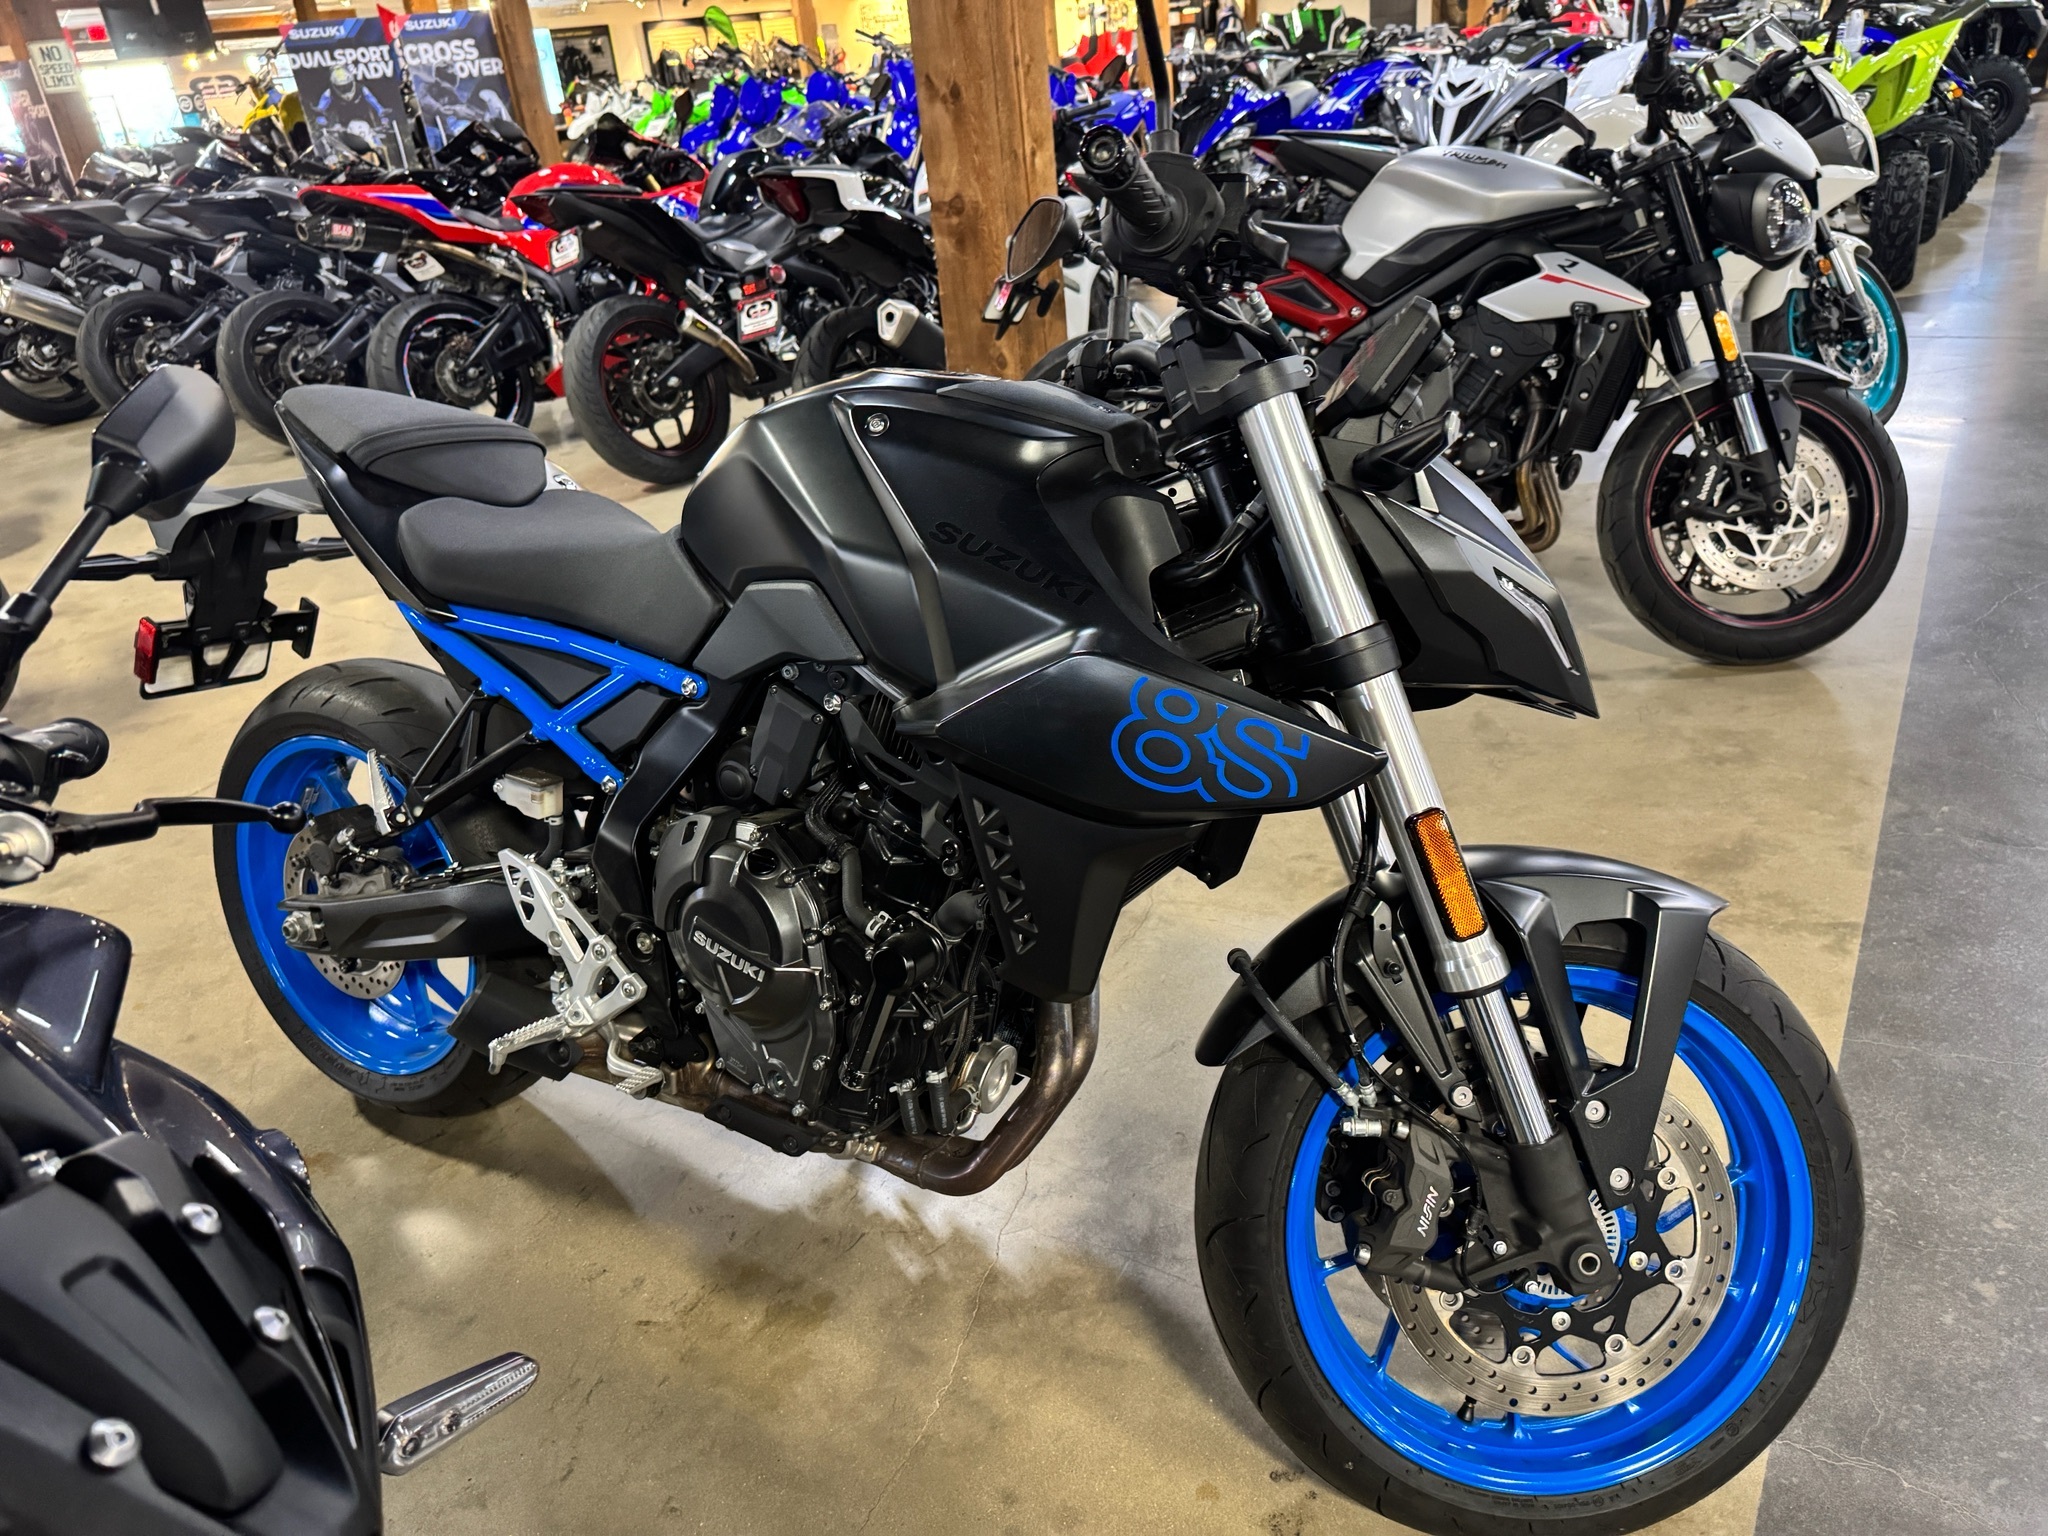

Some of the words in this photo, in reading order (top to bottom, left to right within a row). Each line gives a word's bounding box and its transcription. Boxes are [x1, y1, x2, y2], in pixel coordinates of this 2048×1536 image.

[288, 26, 345, 40] SUZUKI
[404, 17, 456, 31] SUZUKI
[39, 46, 62, 62] NO
[403, 38, 479, 66] CROSS
[38, 64, 73, 77] SPEED
[454, 58, 504, 79] OVER
[43, 75, 76, 88] LIMIT
[928, 521, 1095, 607] SUZUKI
[693, 930, 766, 983] SUZUKI
[1417, 1186, 1439, 1238] NISSIN
